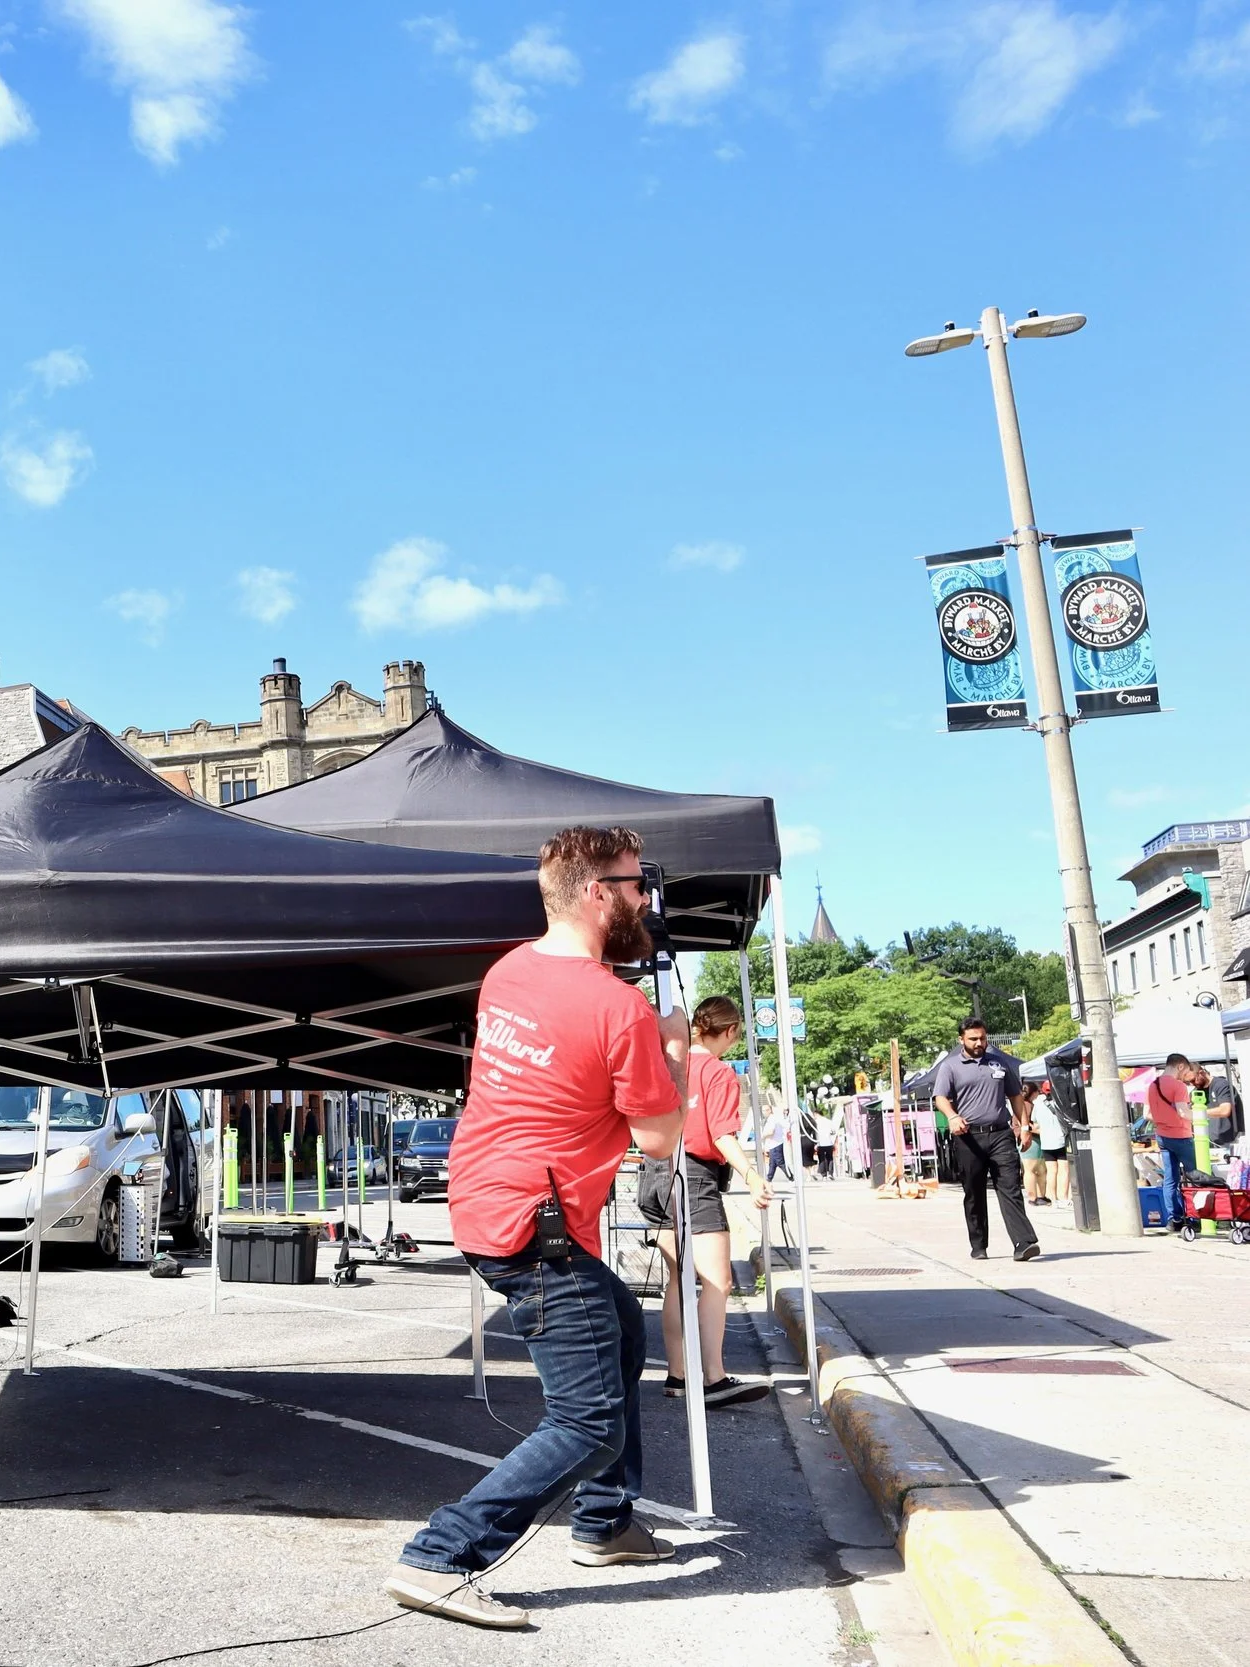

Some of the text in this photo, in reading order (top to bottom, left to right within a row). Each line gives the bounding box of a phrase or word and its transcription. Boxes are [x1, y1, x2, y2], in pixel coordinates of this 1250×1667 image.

[1069, 580, 1140, 615] BYWARD MARKET
[944, 596, 1010, 628] BYWARD MARKET
[1076, 620, 1136, 644] MARCHÉ BY
[951, 637, 1006, 657] MARCHÉ BY
[1142, 657, 1154, 674] BY
[1010, 672, 1022, 689] BY
[1116, 691, 1151, 704] Ottawa
[986, 704, 1020, 719] Ottawa
[513, 1014, 538, 1031] PUBLIC
